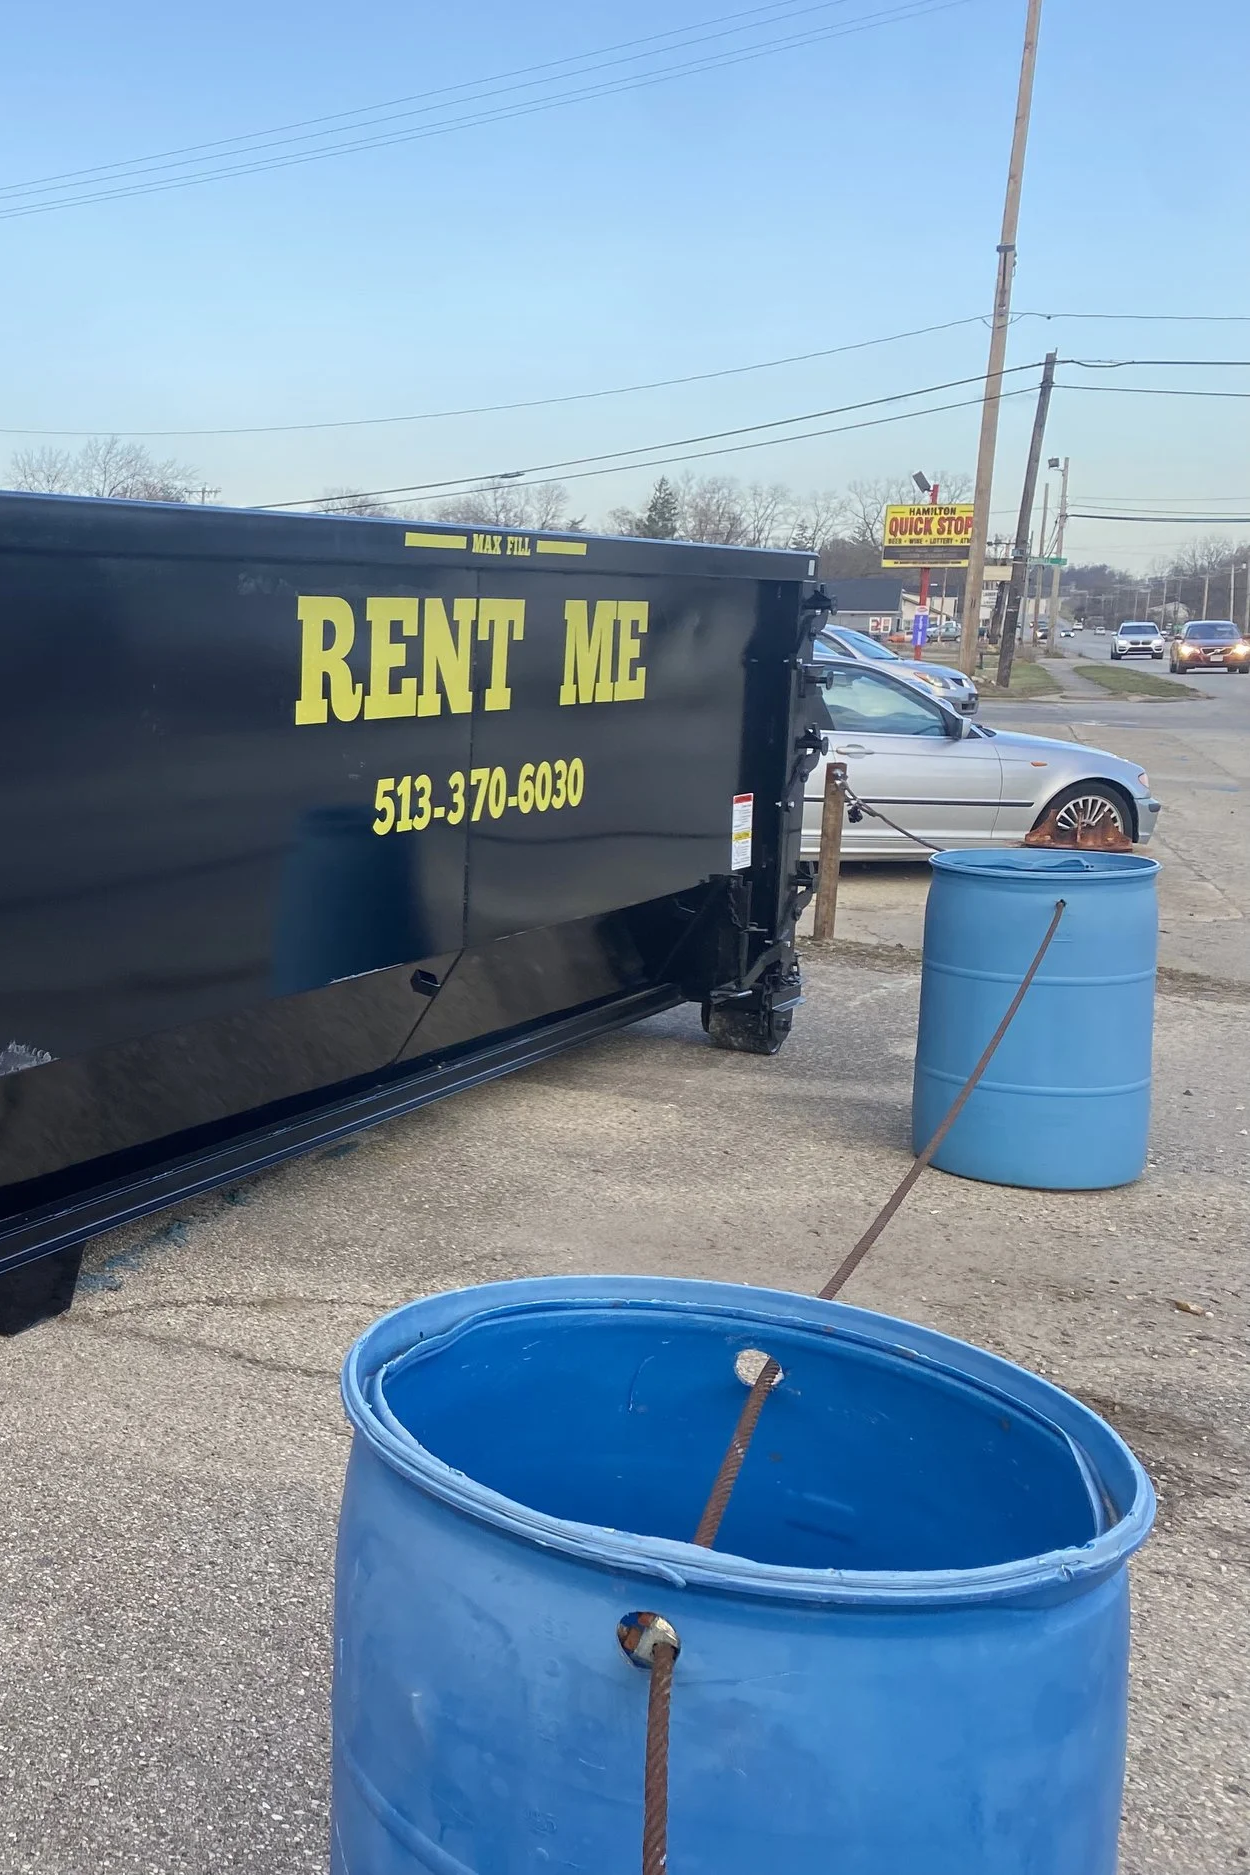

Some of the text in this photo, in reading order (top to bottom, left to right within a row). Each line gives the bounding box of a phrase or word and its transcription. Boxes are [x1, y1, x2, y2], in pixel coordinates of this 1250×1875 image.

[909, 507, 956, 516] HAMILTON
[889, 516, 974, 537] QUICK STOP
[472, 533, 531, 556] MAX FILL
[295, 596, 649, 725] RENT ME
[373, 758, 584, 835] 513-370-6030
